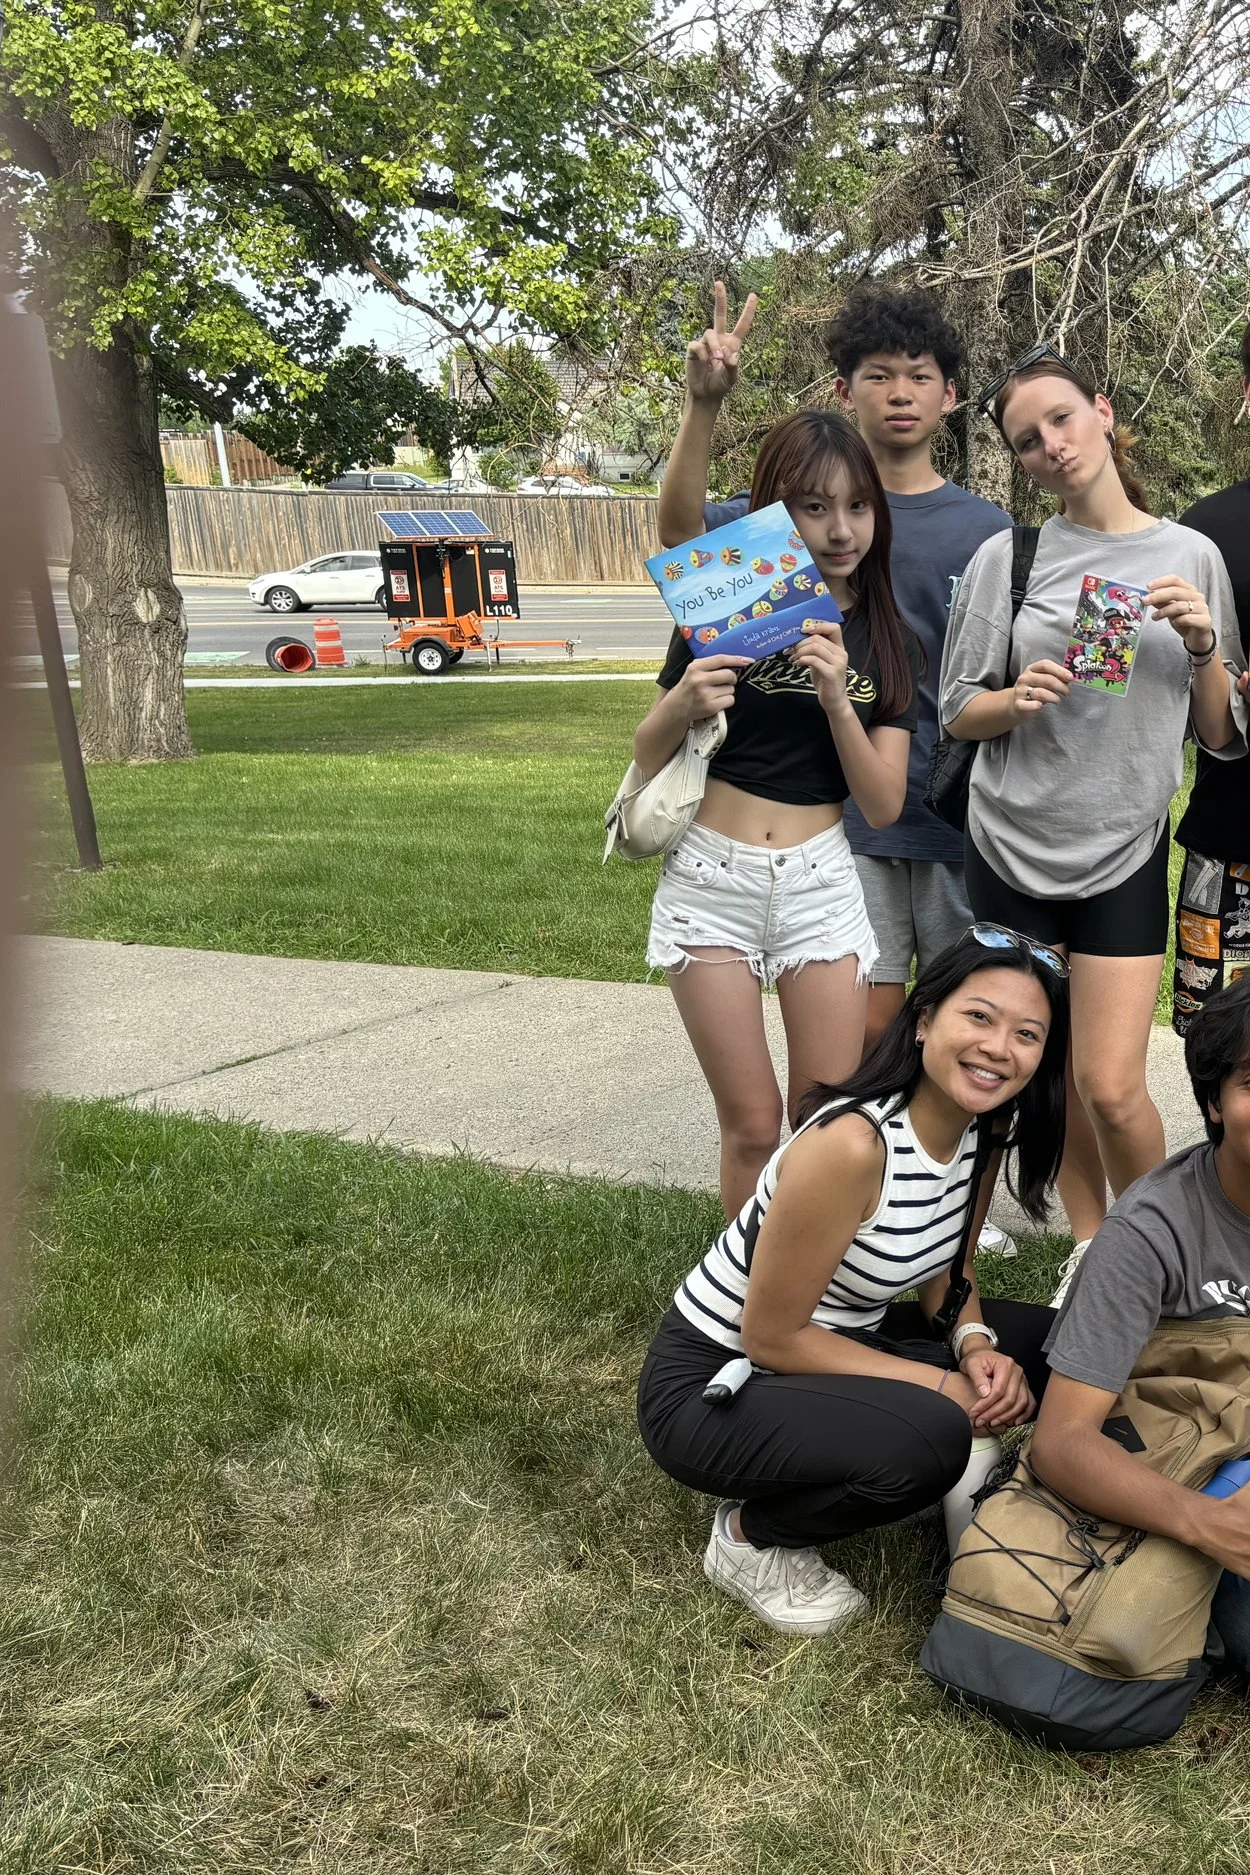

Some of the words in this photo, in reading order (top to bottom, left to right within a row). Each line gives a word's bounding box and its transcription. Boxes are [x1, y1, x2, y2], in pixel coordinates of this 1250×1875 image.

[705, 586, 726, 601] Be
[486, 605, 512, 616] L110
[1073, 655, 1112, 672] Splatoon
[1101, 658, 1127, 682] 2
[1175, 993, 1201, 1009] Dickies
